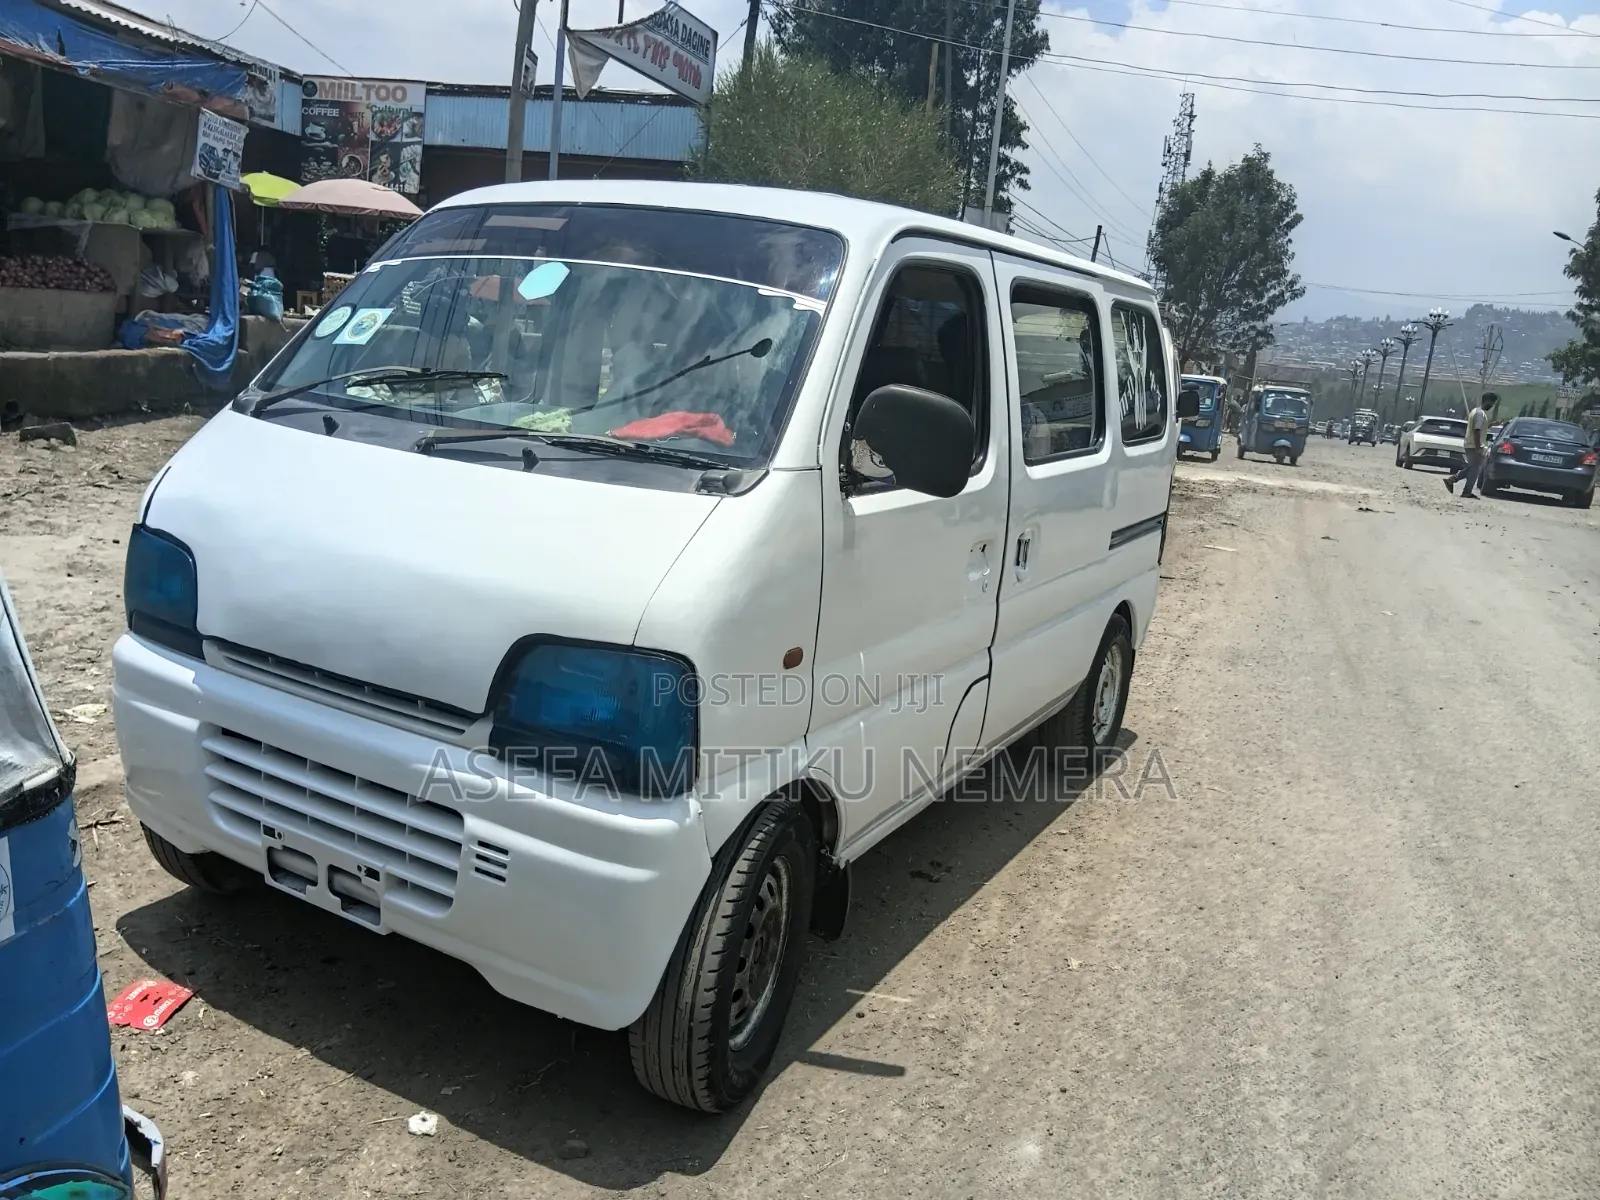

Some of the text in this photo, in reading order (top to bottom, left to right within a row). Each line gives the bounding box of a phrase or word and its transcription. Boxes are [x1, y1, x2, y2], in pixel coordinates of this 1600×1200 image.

[681, 23, 711, 58] DAGINE
[318, 81, 407, 103] MIILTOO
[302, 106, 340, 117] COFFEE
